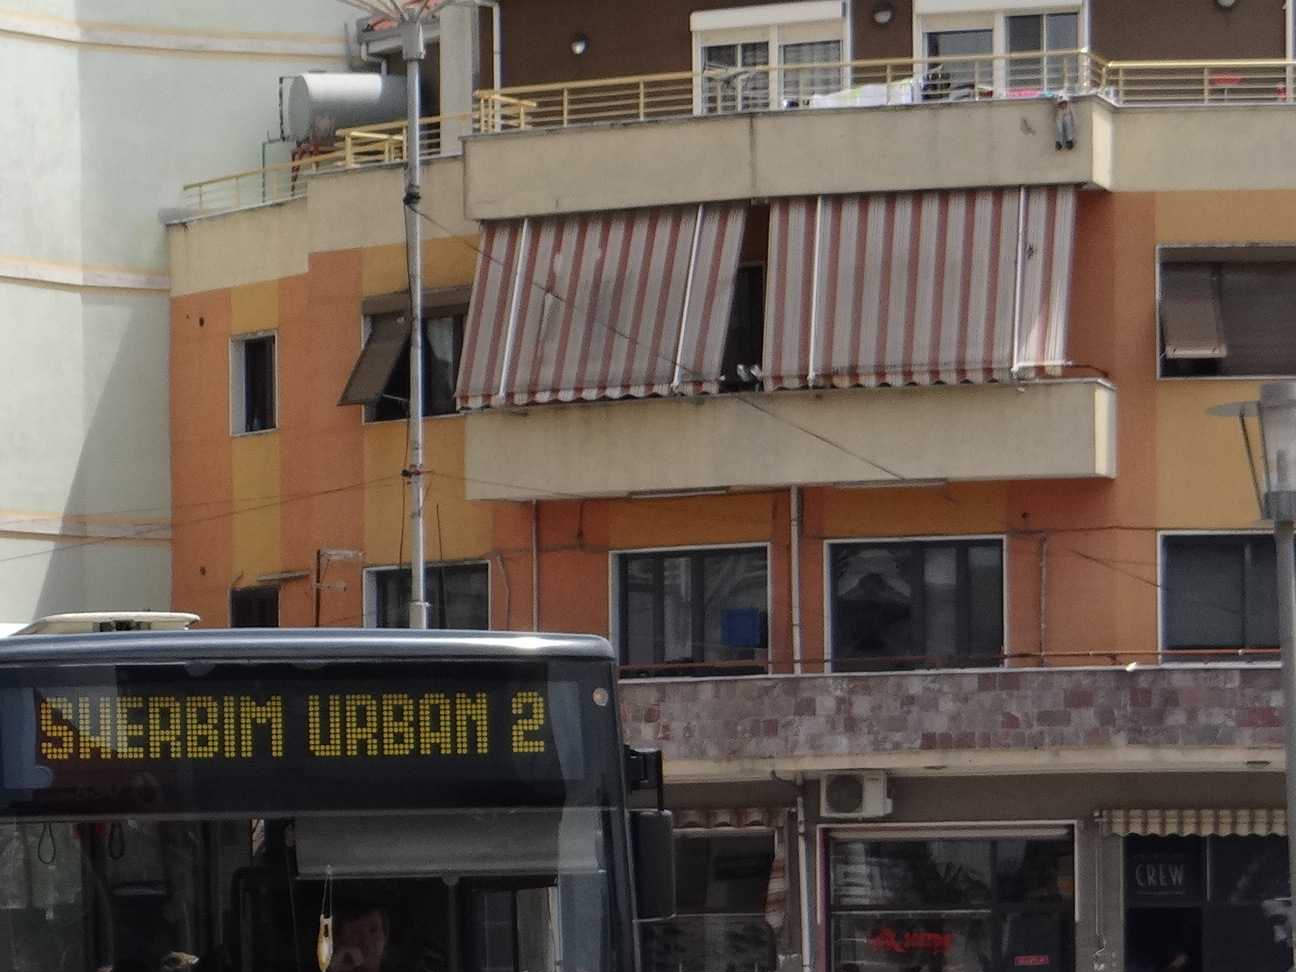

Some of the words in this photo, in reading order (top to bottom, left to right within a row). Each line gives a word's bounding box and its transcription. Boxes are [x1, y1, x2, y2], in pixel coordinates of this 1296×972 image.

[41, 696, 283, 759] SHERBIM
[308, 693, 488, 756] URBAN
[511, 691, 545, 753] 2
[1135, 864, 1184, 886] CREW
